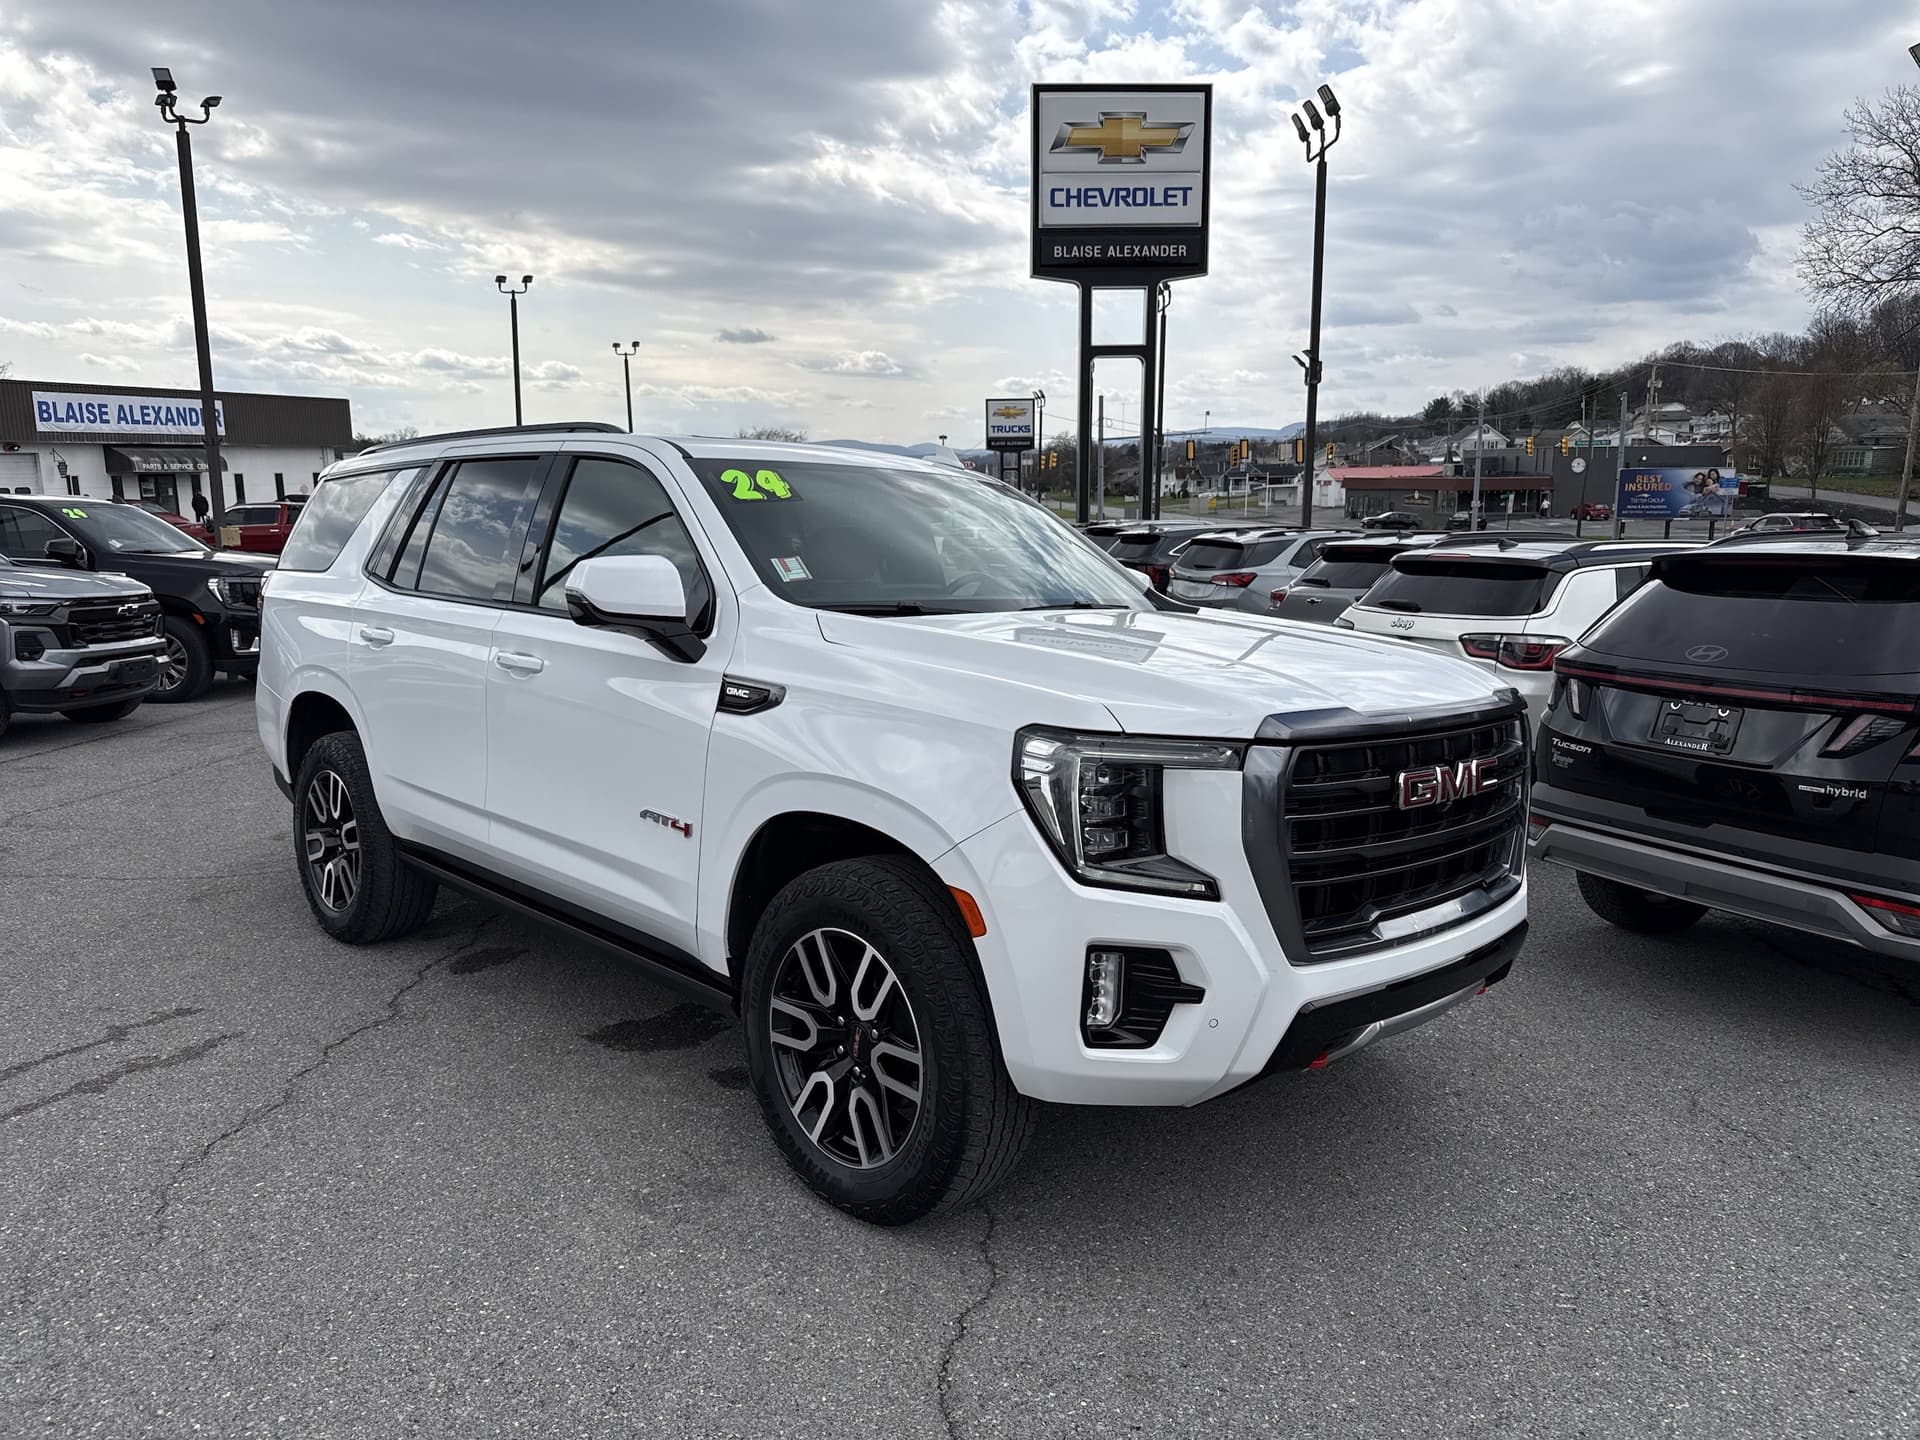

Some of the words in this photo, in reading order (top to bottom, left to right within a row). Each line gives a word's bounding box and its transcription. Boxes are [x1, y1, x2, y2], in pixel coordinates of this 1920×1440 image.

[1049, 187, 1193, 208] CHEVROLET
[1053, 245, 1102, 258] BLAISE
[1107, 245, 1187, 257] ALEXANDER
[37, 400, 110, 424] BLAISE
[116, 404, 222, 427] ALEXANDR
[991, 424, 1031, 433] TRUCKS
[169, 463, 194, 471] SERVICE
[720, 469, 792, 500] 24
[1635, 474, 1664, 483] REST
[1624, 483, 1673, 492] INSURED
[726, 687, 750, 698] GMC
[1398, 759, 1498, 810] GMC
[1825, 785, 1867, 799] hybrid
[639, 809, 693, 839] AT4
